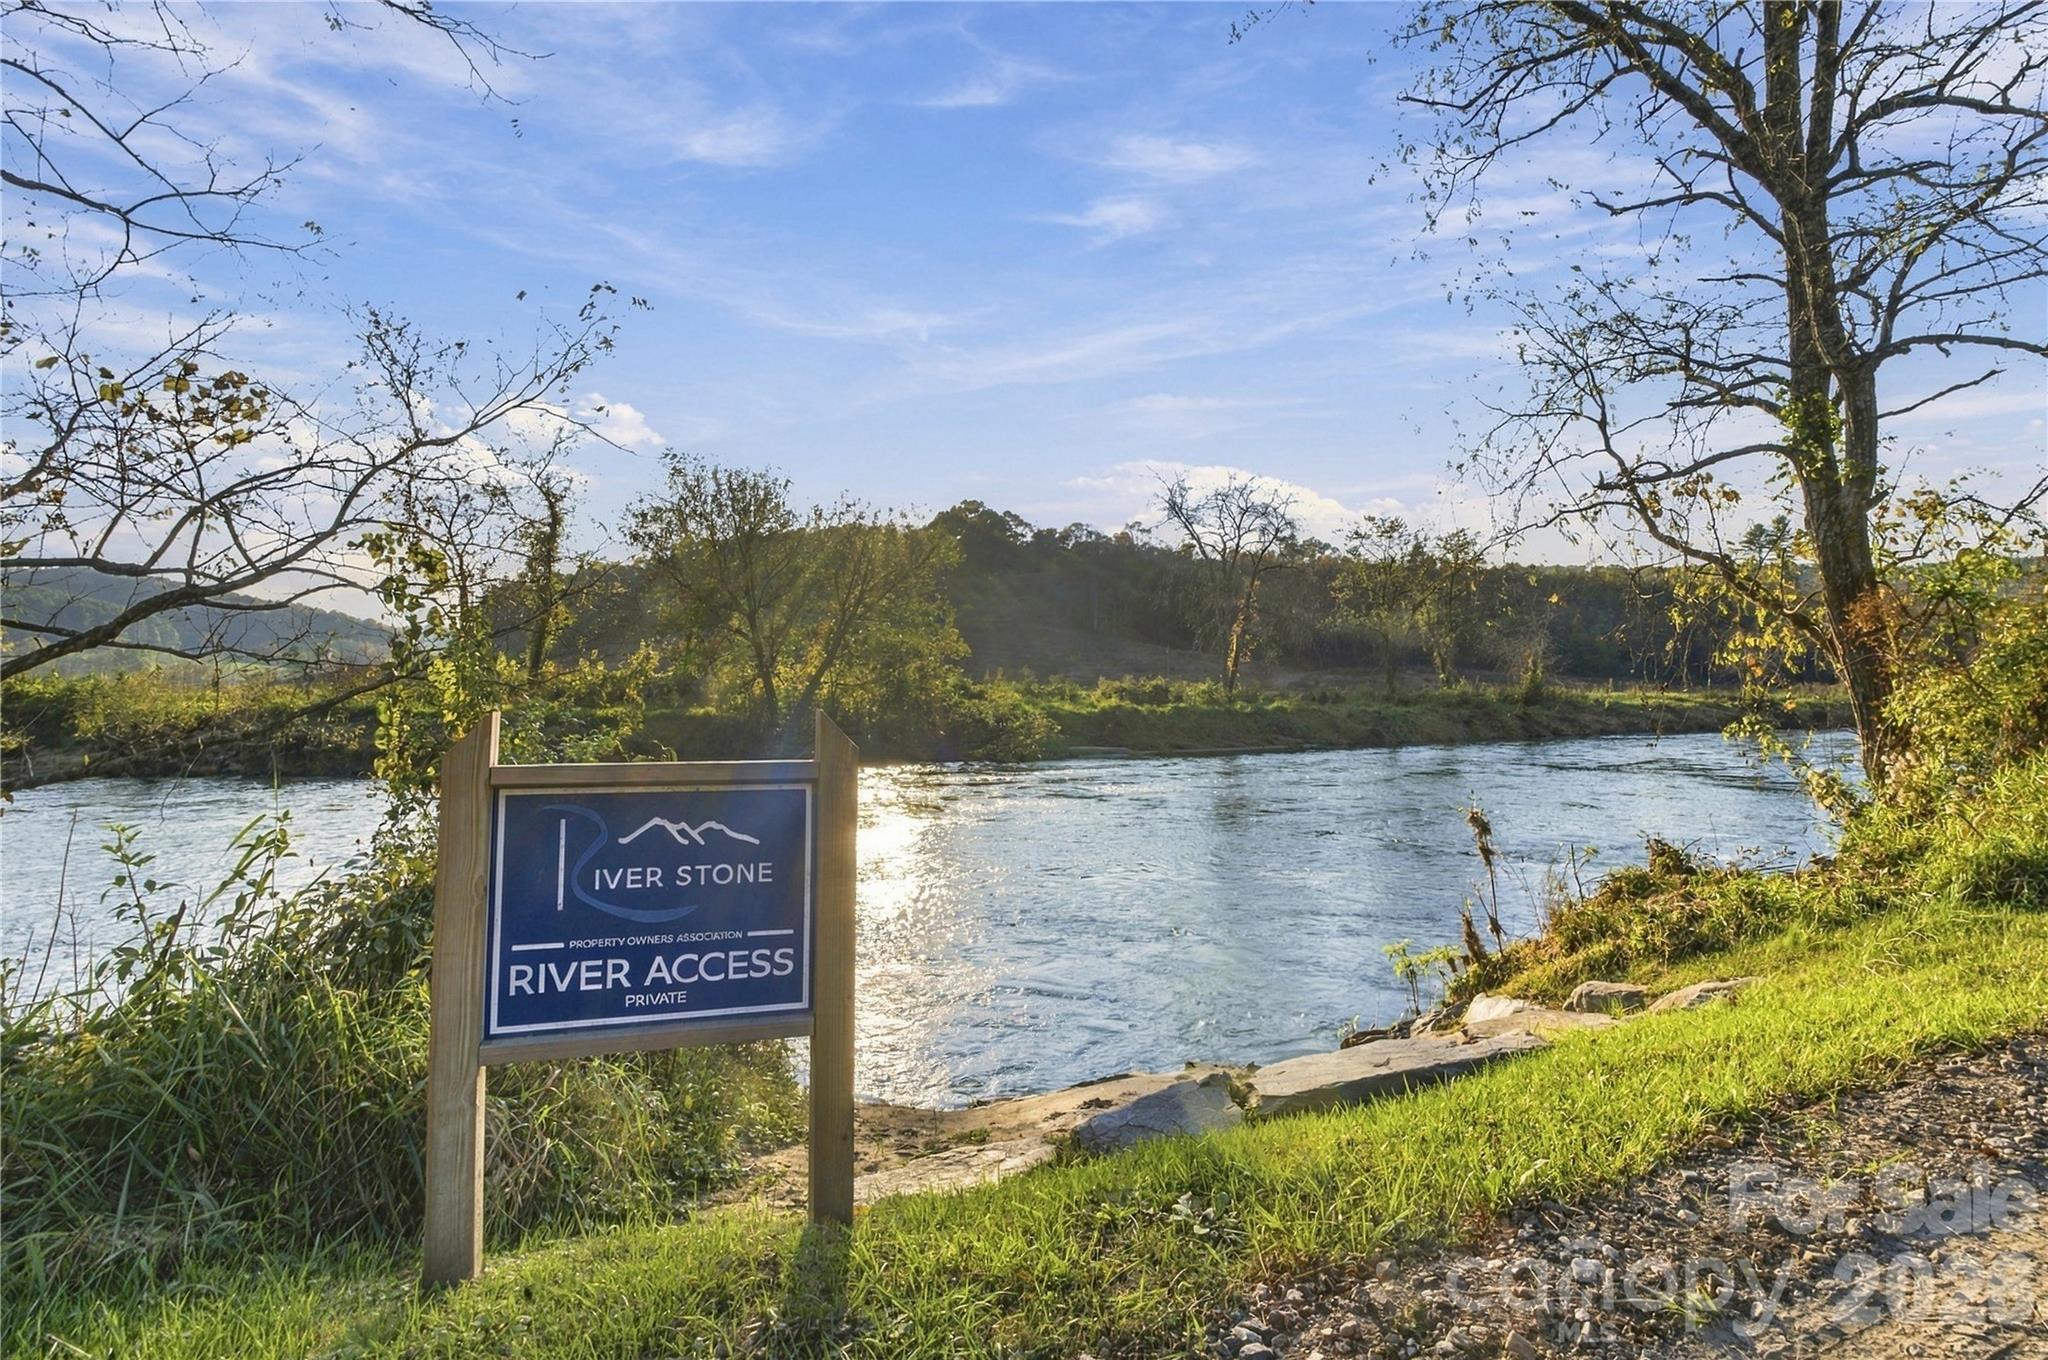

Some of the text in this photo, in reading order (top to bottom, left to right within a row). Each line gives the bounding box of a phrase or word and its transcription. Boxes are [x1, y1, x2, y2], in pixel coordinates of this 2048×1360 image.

[675, 862, 774, 887] STONE
[569, 931, 742, 950] PROPERTY OWNERS ASSOCIATION
[508, 948, 795, 997] RIVER ACCESS
[624, 991, 688, 1008] PRIVATE
